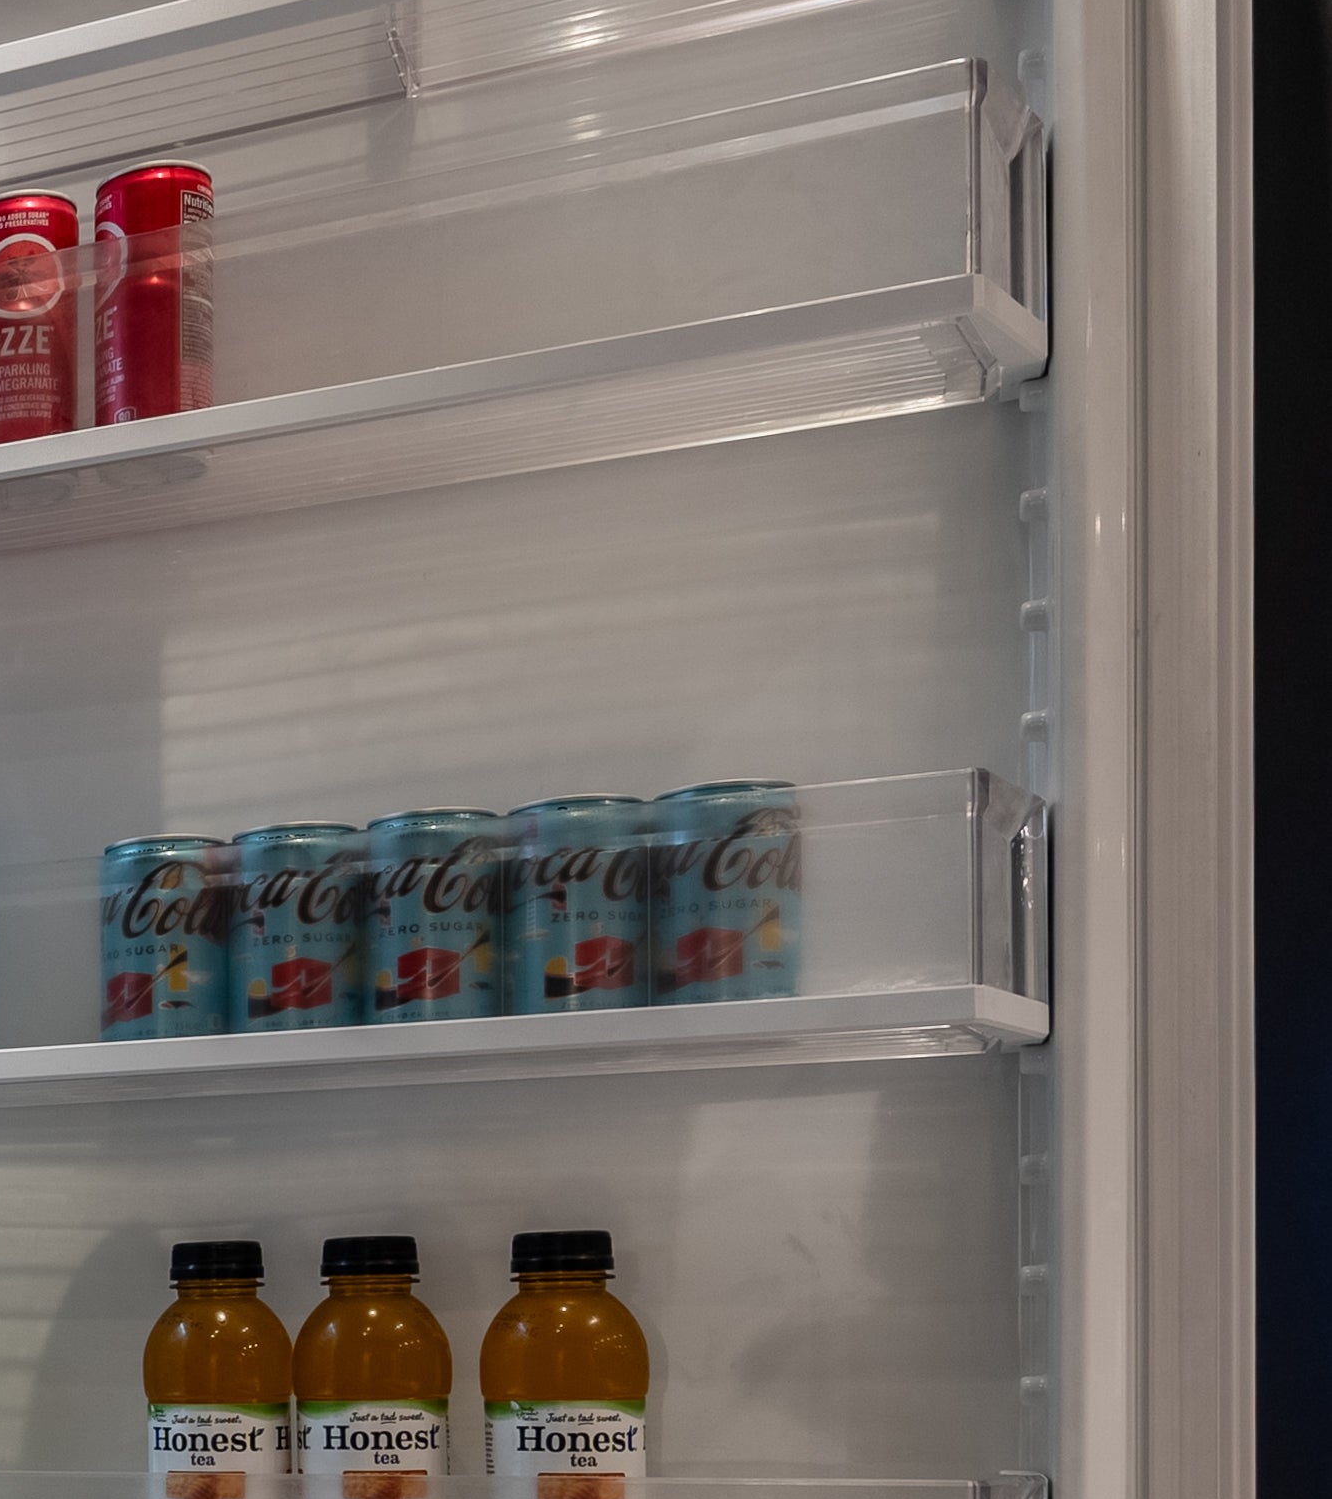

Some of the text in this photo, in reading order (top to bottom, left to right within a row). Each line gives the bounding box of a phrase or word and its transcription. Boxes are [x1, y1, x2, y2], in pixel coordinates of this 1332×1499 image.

[4, 218, 49, 230] PRESERVATIVES
[6, 212, 27, 222] ADDED
[550, 910, 599, 923] ZERO
[378, 923, 420, 938] ZERO
[252, 933, 293, 946] ZERO
[153, 1426, 263, 1452] Honest
[323, 1425, 439, 1451] Honest
[516, 1425, 636, 1452] Honest
[190, 1453, 216, 1466] tea
[373, 1451, 400, 1465] tea
[569, 1452, 598, 1468] tea
